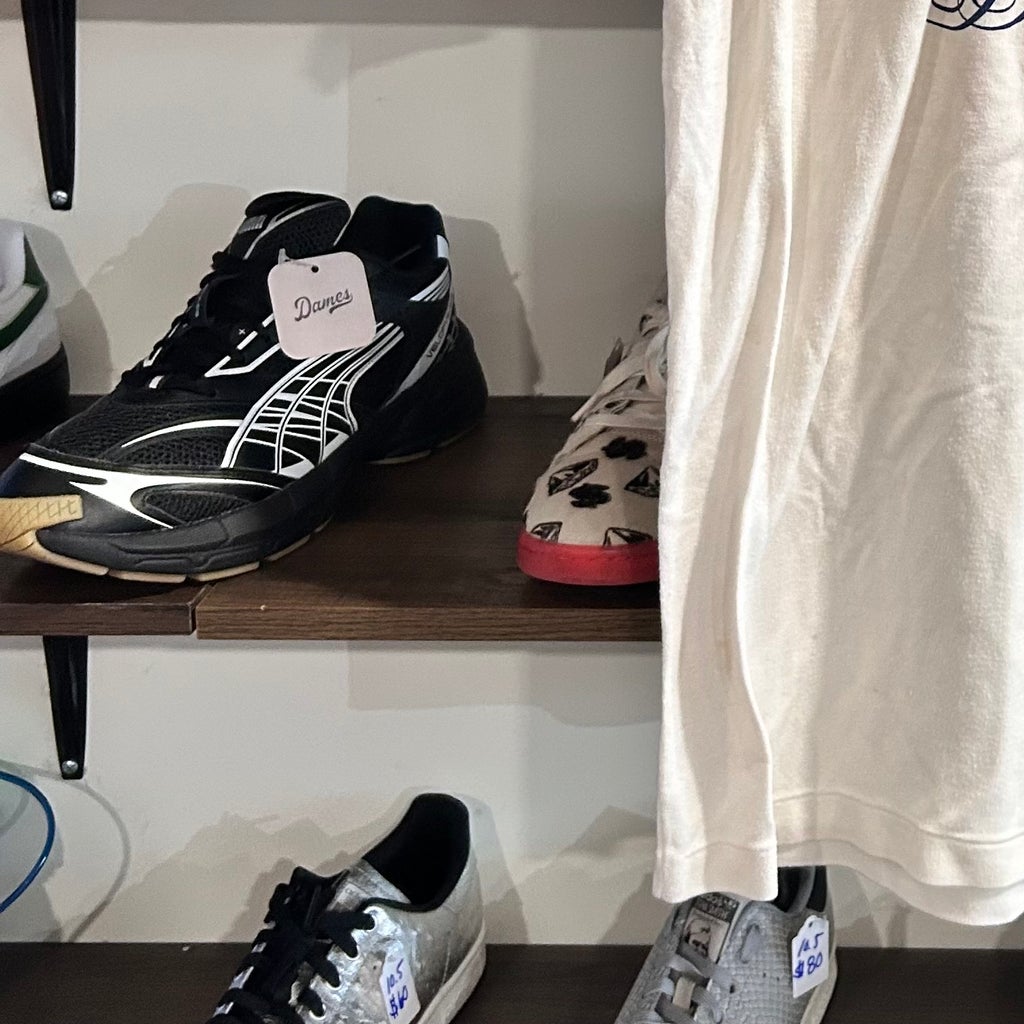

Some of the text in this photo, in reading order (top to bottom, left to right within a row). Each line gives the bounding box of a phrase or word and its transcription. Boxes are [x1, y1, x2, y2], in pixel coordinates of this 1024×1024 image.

[294, 289, 353, 321] Dames
[387, 959, 404, 994] 10.5
[793, 952, 824, 978] $80
